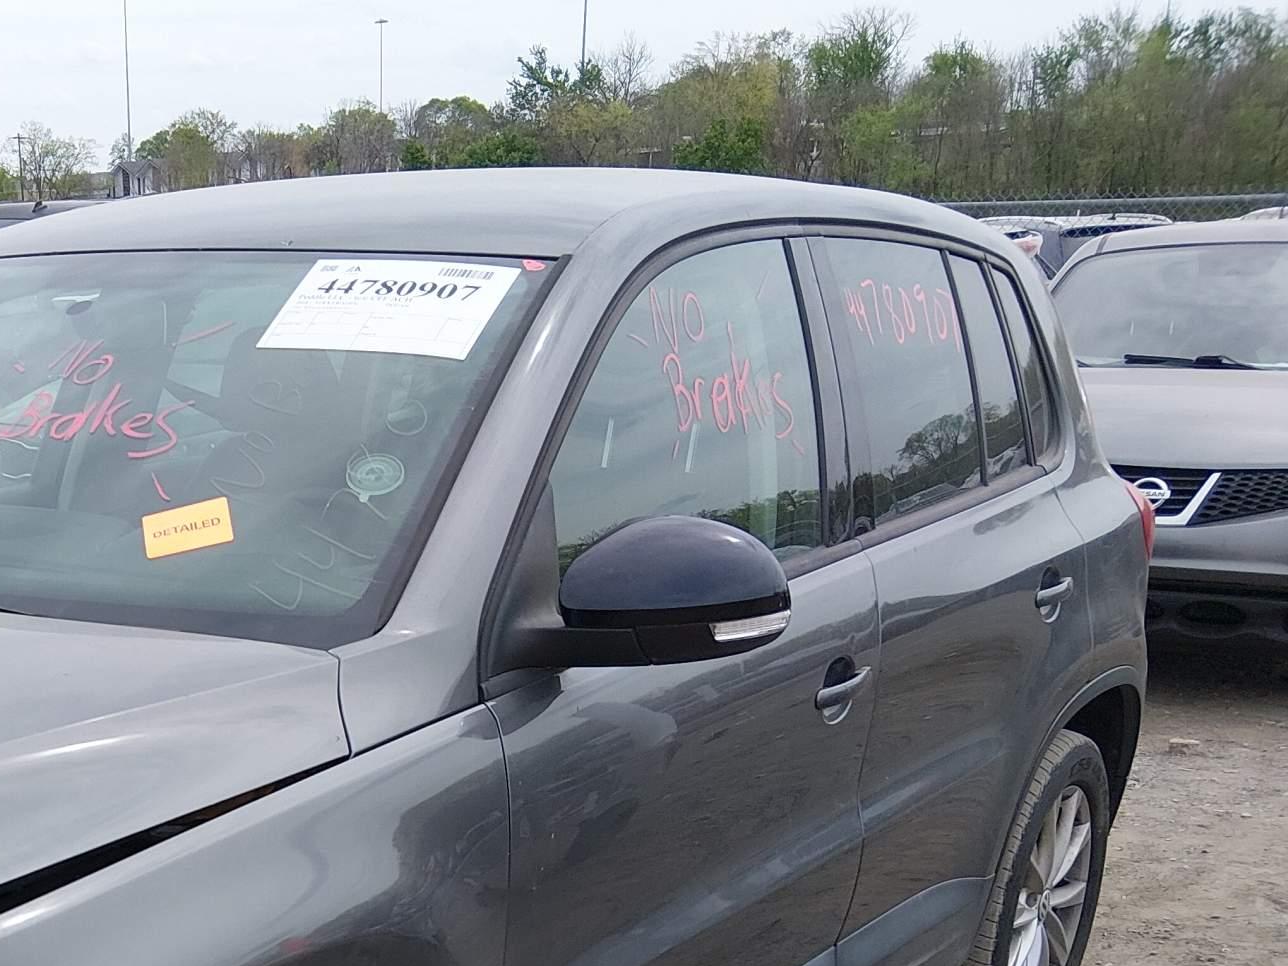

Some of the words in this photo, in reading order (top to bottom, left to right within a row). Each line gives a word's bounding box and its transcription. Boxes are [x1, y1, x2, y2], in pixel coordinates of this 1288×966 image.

[318, 278, 482, 301] 44780907
[650, 286, 705, 352] NO
[152, 516, 221, 539] DETAILED
